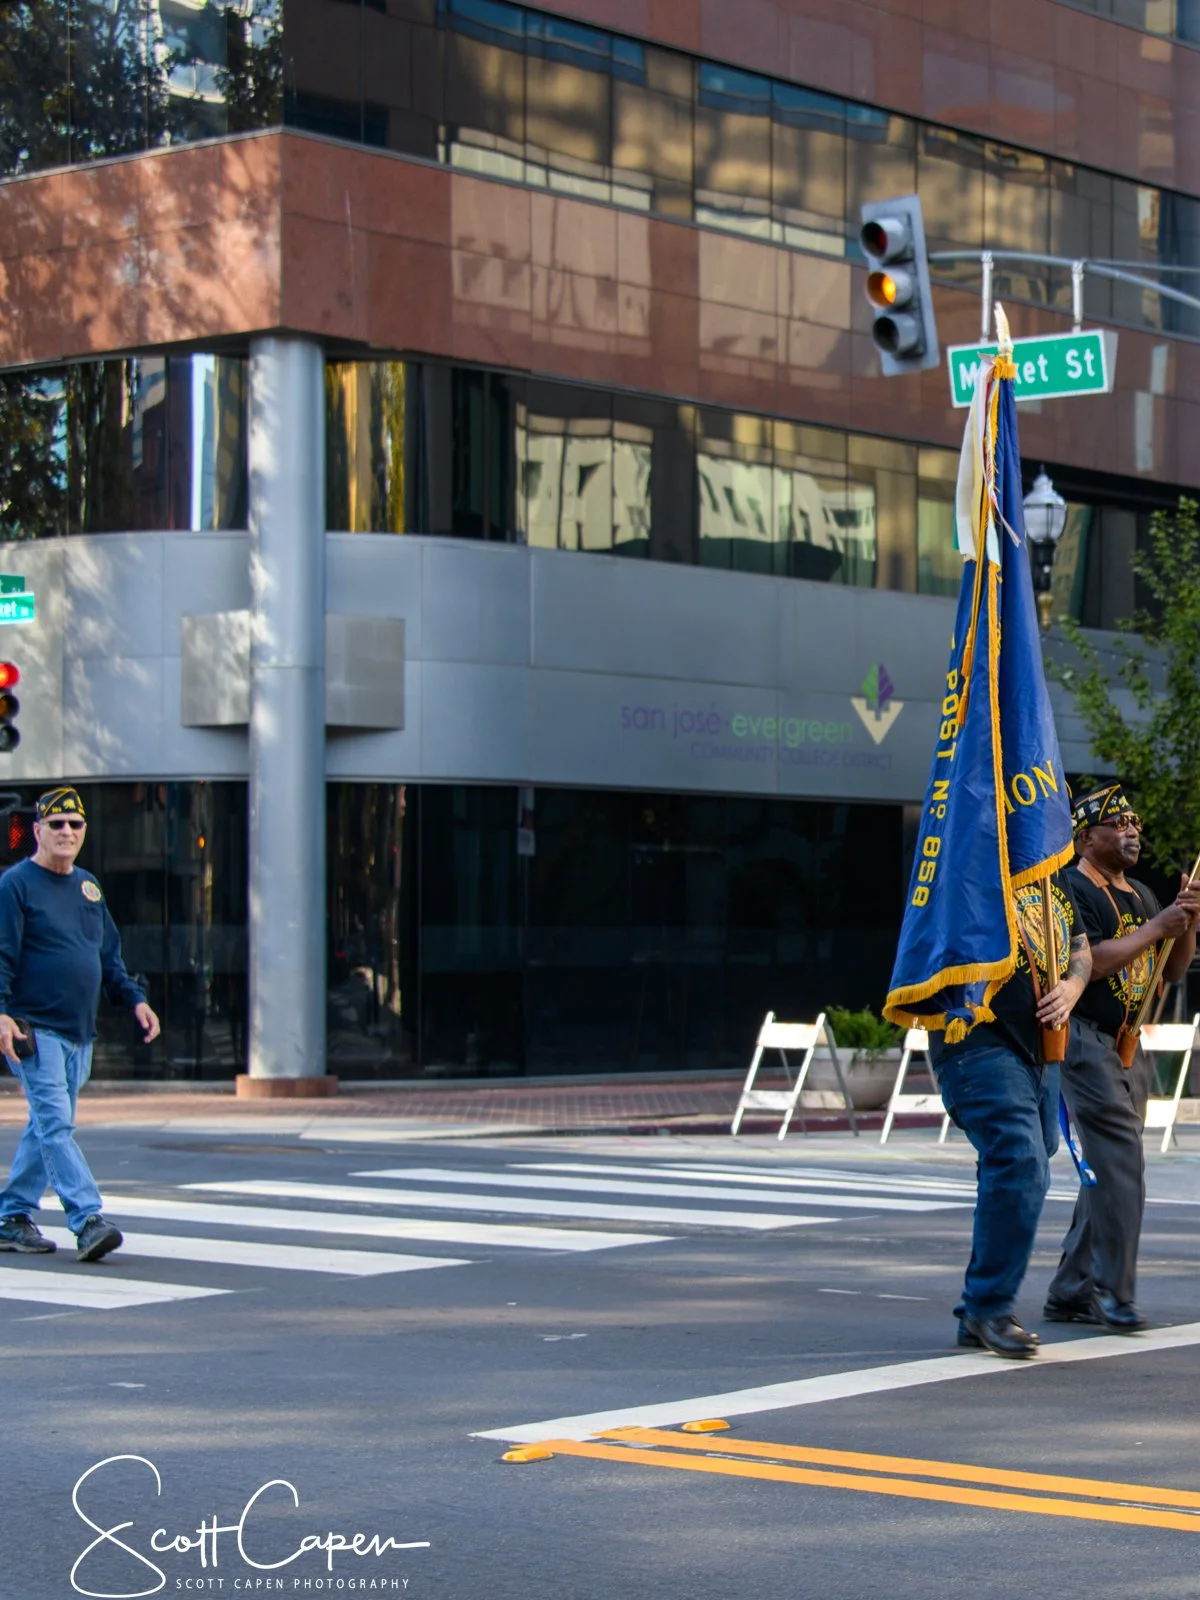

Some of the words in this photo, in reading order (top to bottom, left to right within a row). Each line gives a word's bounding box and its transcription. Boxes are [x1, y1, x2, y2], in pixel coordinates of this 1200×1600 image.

[959, 353, 1049, 391] Met
[1065, 348, 1096, 380] St
[620, 705, 666, 731] san
[673, 702, 721, 739] josé
[731, 713, 854, 748] evergreen
[937, 667, 960, 763] POST
[911, 836, 942, 908] 858
